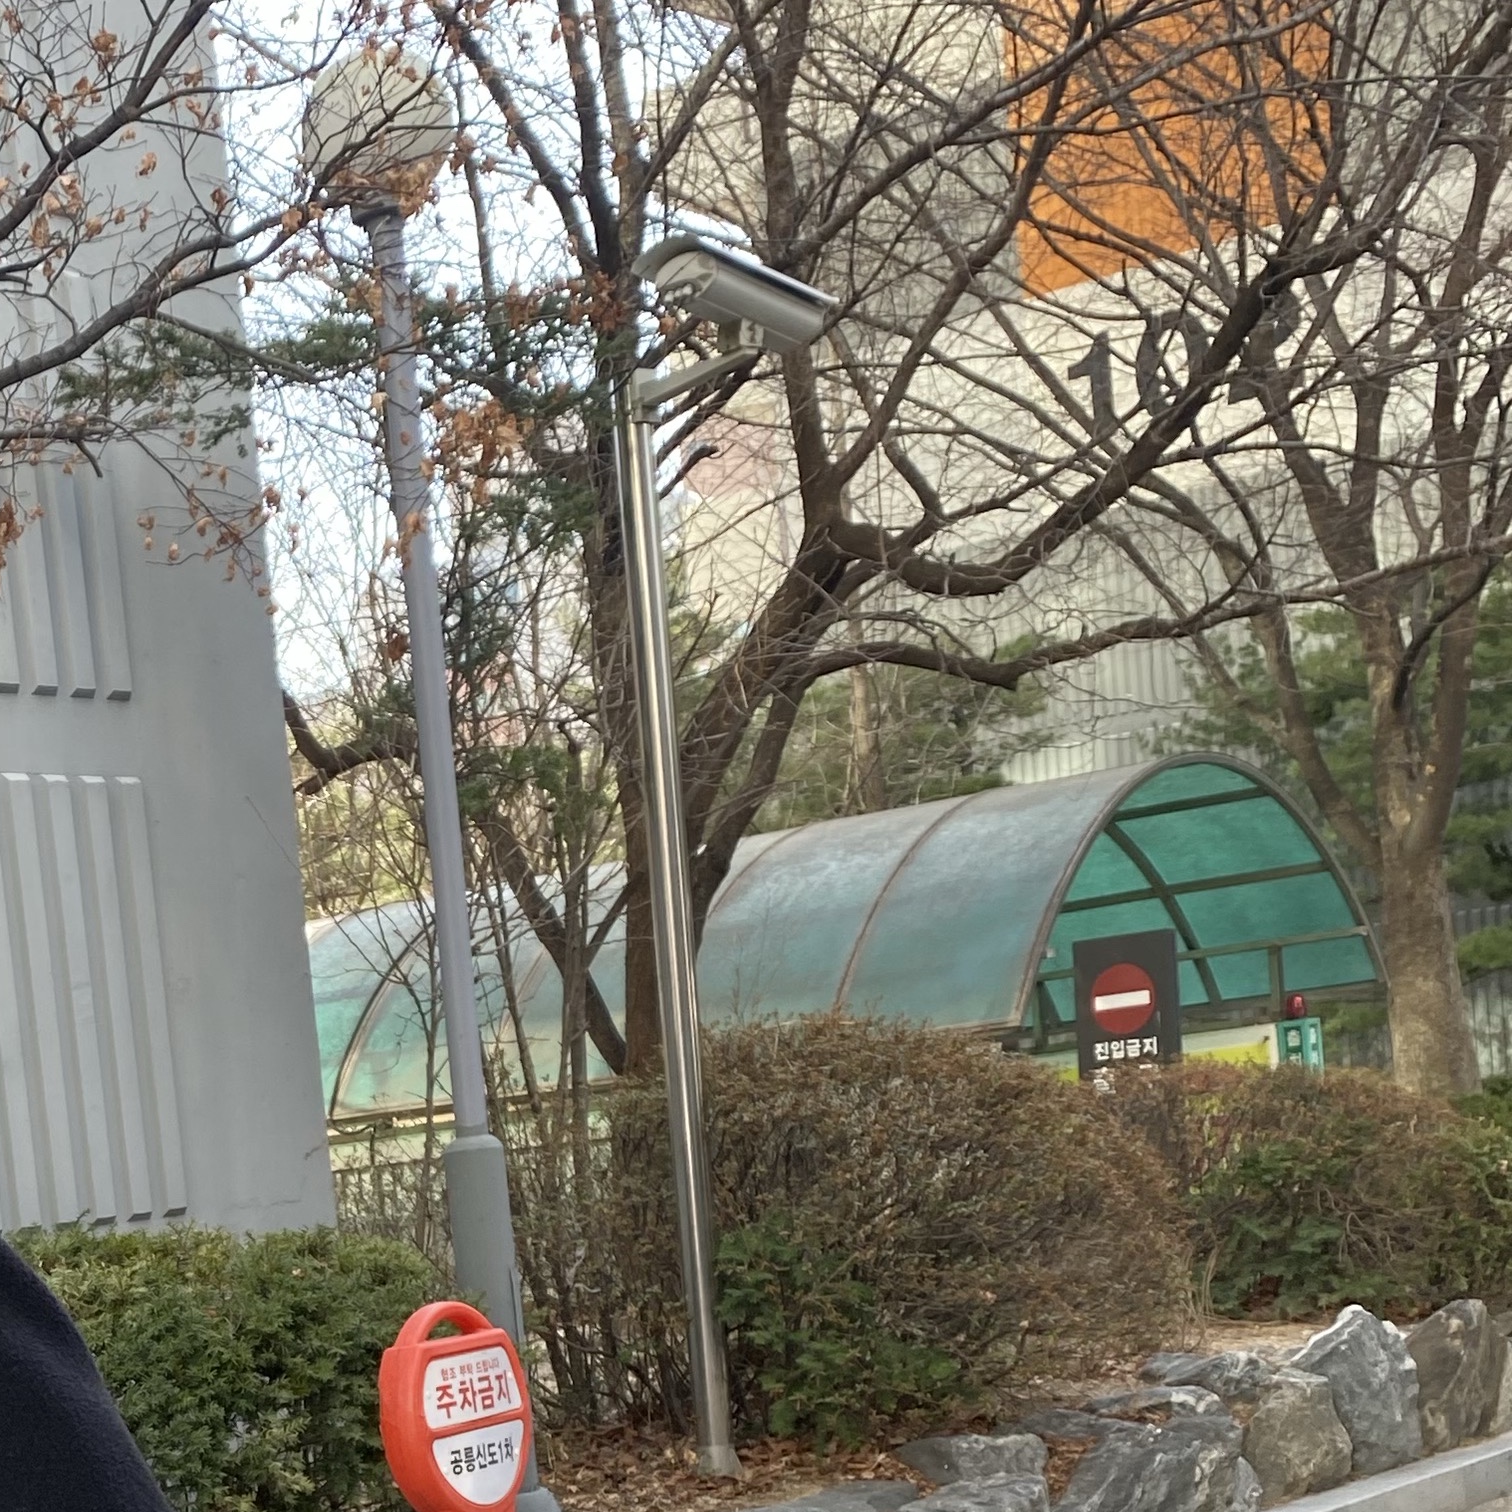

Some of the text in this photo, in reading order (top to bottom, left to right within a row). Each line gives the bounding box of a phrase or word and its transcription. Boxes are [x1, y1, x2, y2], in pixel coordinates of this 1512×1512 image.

[1094, 1036, 1158, 1061] 진입금지
[459, 1361, 474, 1376] 부탁
[436, 1369, 511, 1419] 주차금지
[450, 1436, 514, 1476] 공릉신도1차
